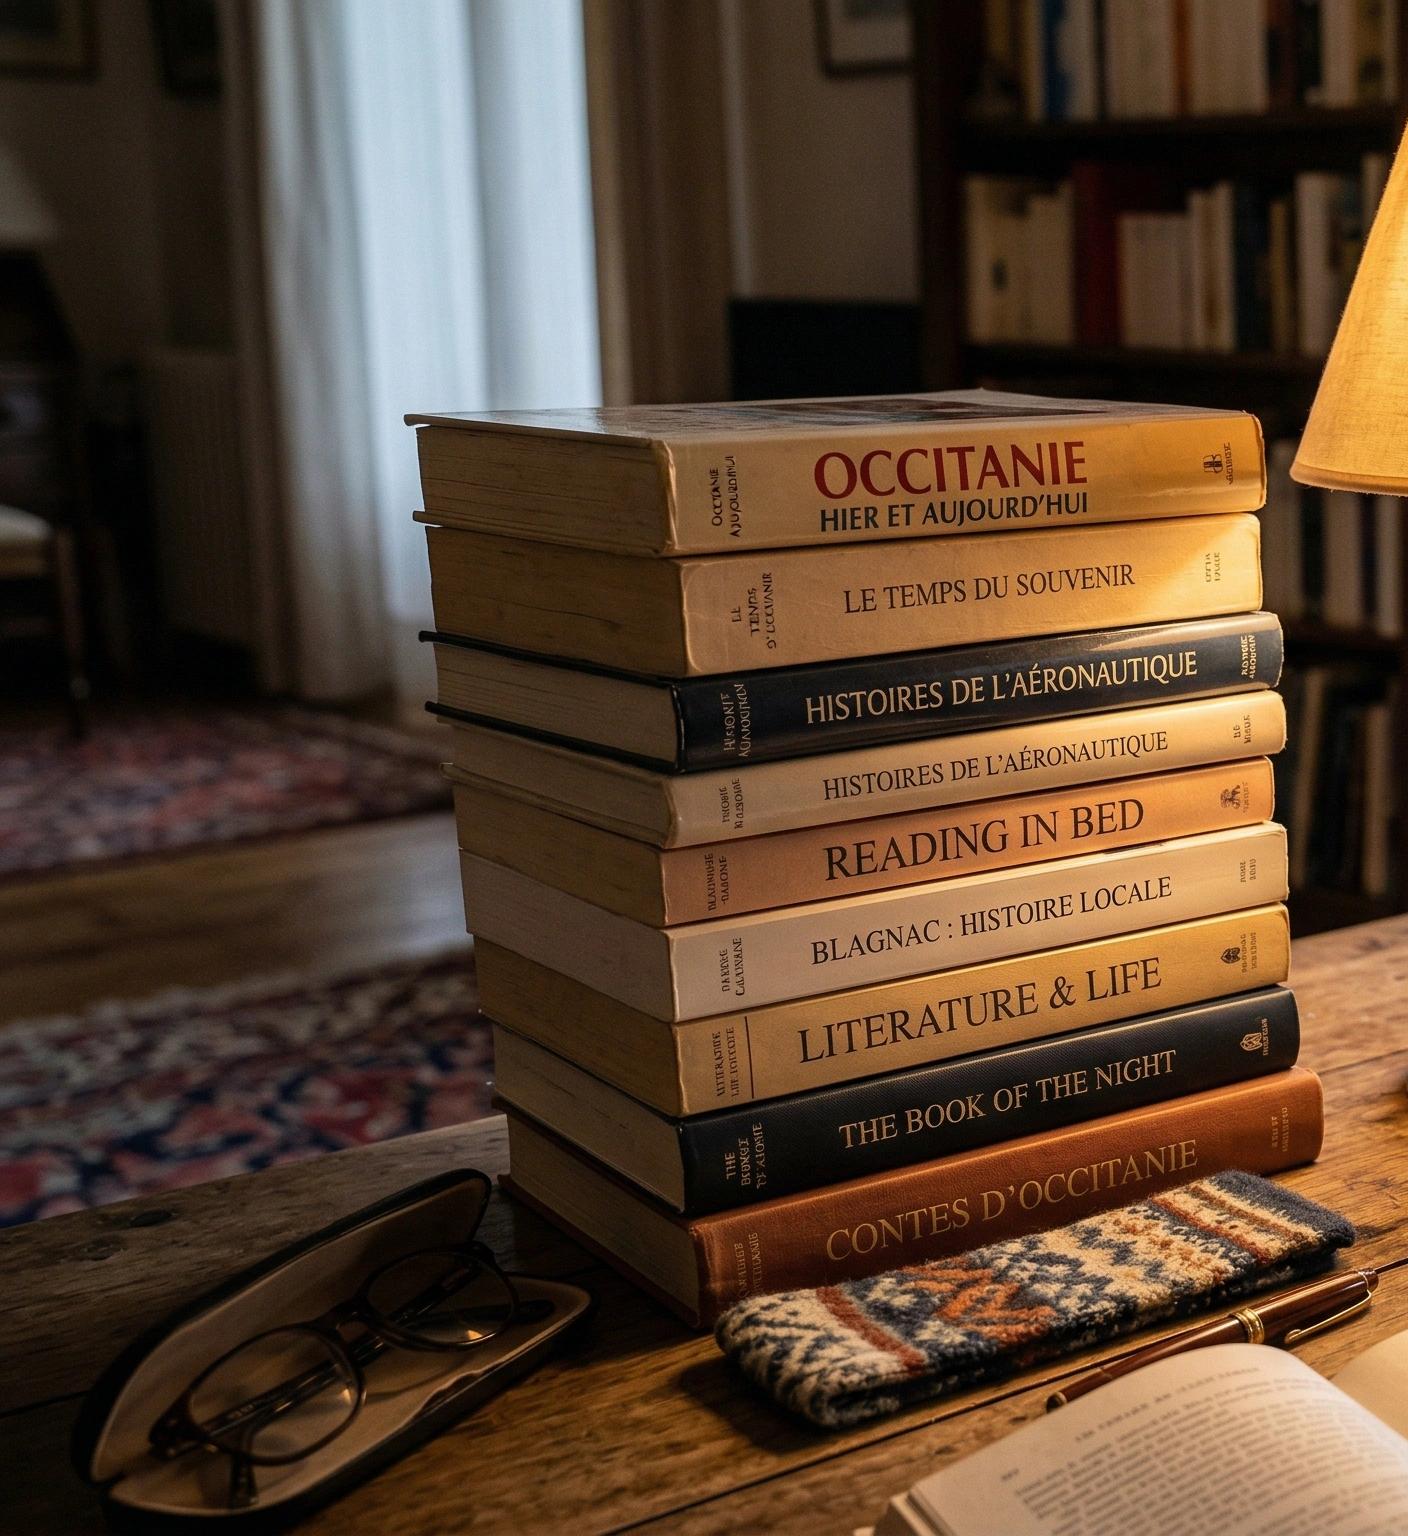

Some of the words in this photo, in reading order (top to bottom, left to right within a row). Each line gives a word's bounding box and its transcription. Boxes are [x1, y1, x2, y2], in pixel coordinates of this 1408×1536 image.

[813, 441, 1088, 500] OCCITANIE
[820, 506, 879, 532] HIER
[887, 503, 915, 527] ET
[922, 492, 1088, 526] AUJOURD'HUI
[843, 588, 877, 614] LE
[883, 579, 967, 610] TEMPS
[973, 575, 1009, 600] DU
[1016, 563, 1136, 597] SOUVENIR
[805, 682, 945, 726] HISTOIRES
[951, 673, 986, 707] DE
[992, 649, 1199, 702] L'AÉRONAUTIQUE
[822, 760, 945, 801] HISTOIRES
[950, 754, 981, 780] DE
[985, 730, 1169, 777] L'AÉRONAUTIQUE
[823, 819, 1010, 882] READING
[1018, 811, 1060, 850] IN
[1069, 797, 1145, 841] BED
[811, 919, 941, 965] BLAGNAC
[947, 922, 954, 940] :
[960, 894, 1074, 937] HISTOIRE
[1080, 876, 1173, 914] LOCALE
[797, 981, 1039, 1064] LITERATURE
[1049, 974, 1077, 1009] &
[1085, 957, 1162, 1001] LIFE
[839, 1120, 899, 1150] THE
[905, 1096, 988, 1135] BOOK
[994, 1083, 1030, 1112] OF
[1036, 1070, 1088, 1103] THE
[1094, 1049, 1177, 1090] NIGHT
[826, 1197, 971, 1261] CONTES
[980, 1139, 1200, 1222] D'OCCITANIE
